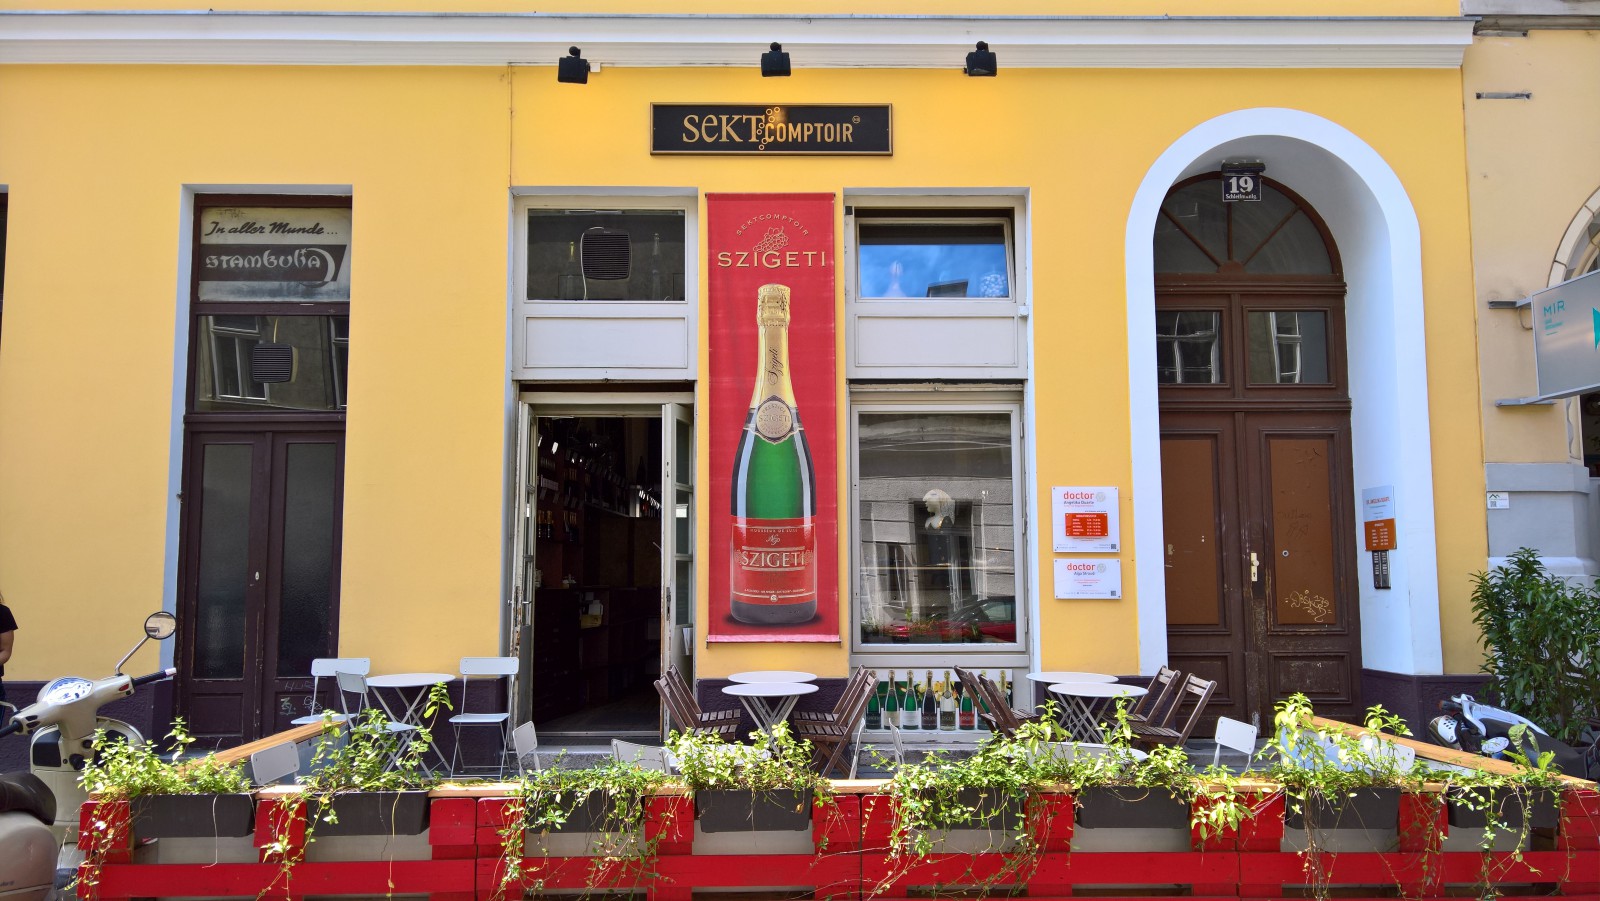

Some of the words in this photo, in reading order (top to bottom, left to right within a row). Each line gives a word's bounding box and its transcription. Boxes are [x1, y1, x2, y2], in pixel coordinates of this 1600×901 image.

[1229, 176, 1254, 193] 19
[228, 221, 265, 235] aller
[736, 213, 809, 236] SEKTCOMPTOIR
[717, 250, 827, 269] SZIGETI
[1544, 300, 1565, 316] MIR
[1064, 491, 1094, 499] doctor
[741, 551, 805, 567] SZIGETI
[1067, 562, 1095, 570] doctor
